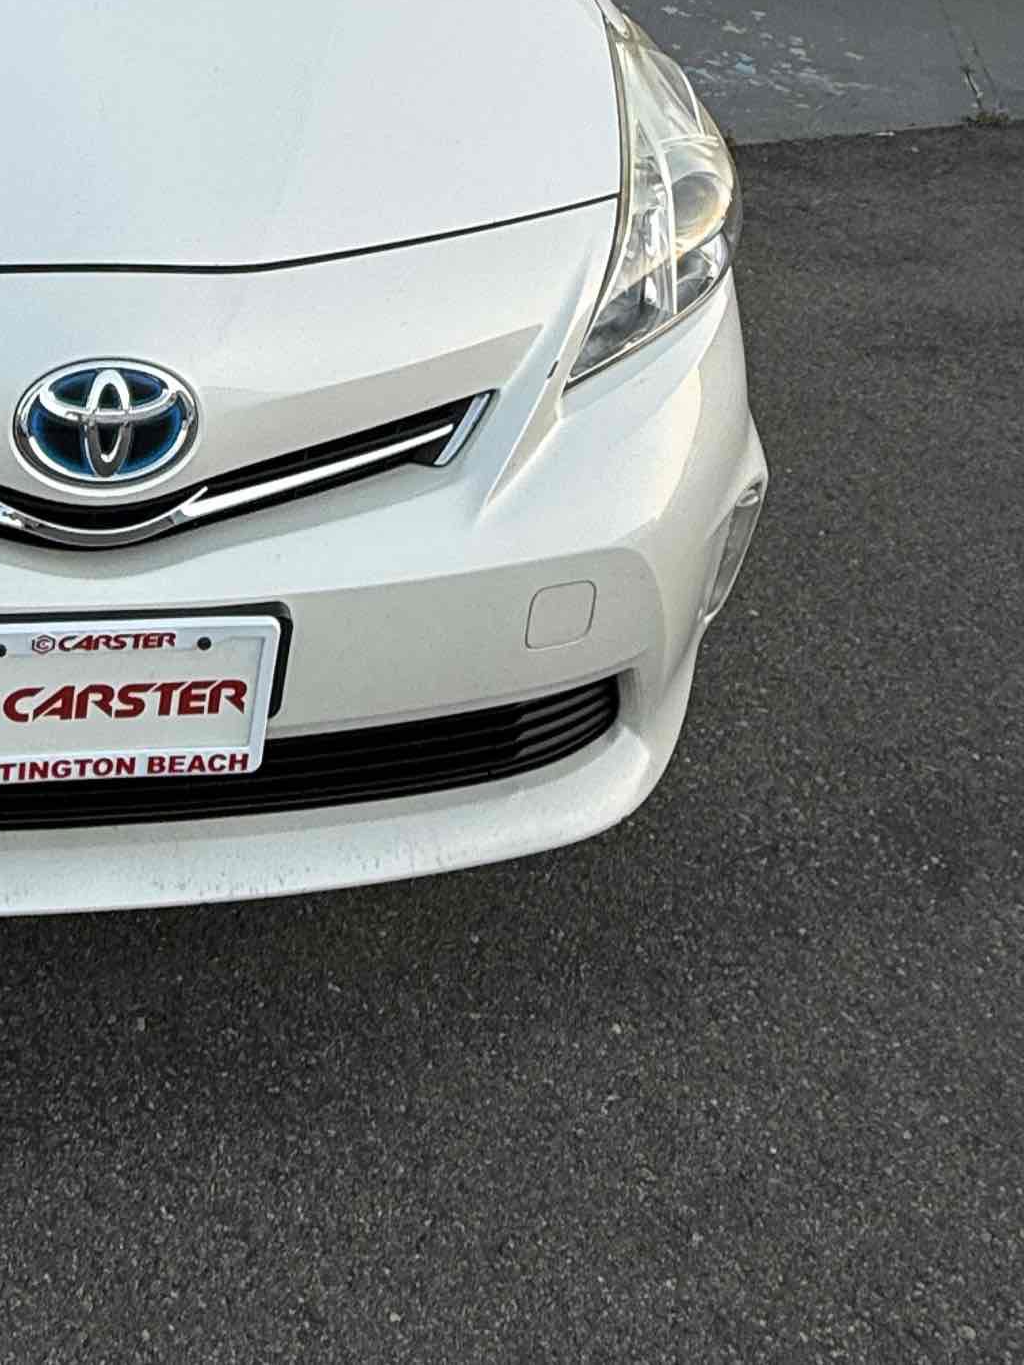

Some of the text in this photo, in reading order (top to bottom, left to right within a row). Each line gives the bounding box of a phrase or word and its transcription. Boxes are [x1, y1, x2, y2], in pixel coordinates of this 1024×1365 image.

[58, 632, 176, 652] CARSTER
[3, 678, 248, 723] CARSTER
[147, 753, 249, 775] BEACH
